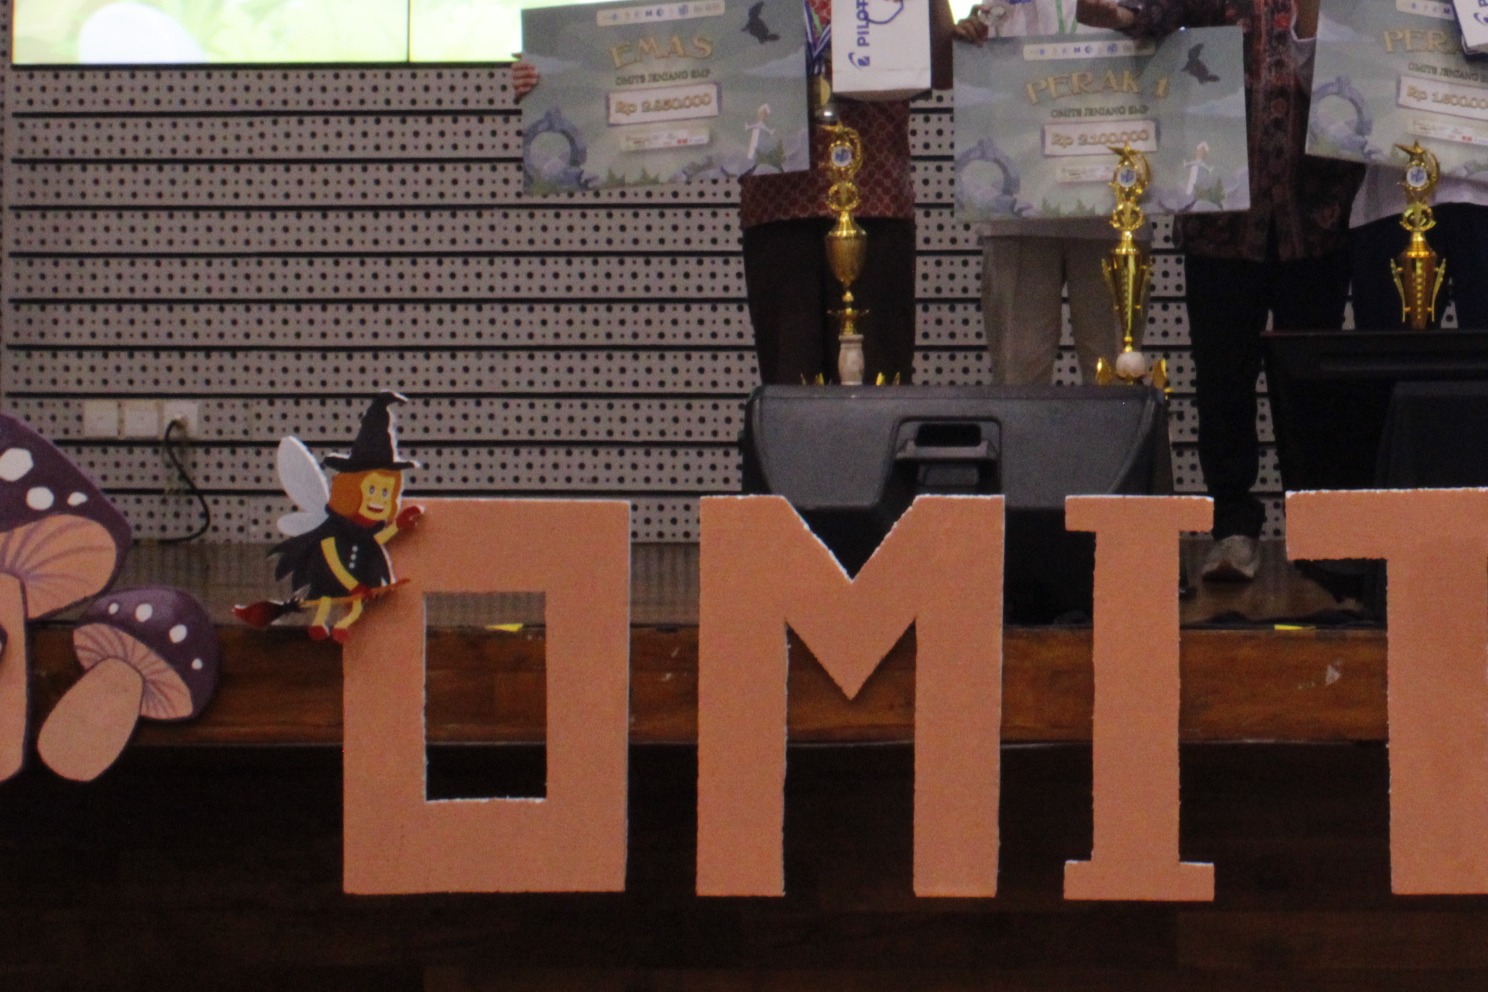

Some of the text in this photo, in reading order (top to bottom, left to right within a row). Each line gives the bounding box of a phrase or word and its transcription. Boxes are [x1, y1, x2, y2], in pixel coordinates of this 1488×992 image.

[856, 0, 870, 47] PILOT
[608, 33, 714, 69] EMAS
[1025, 70, 1142, 105] PERAK
[1407, 85, 1428, 101] Rp
[615, 100, 638, 116] Rp
[1051, 133, 1074, 148] Rp
